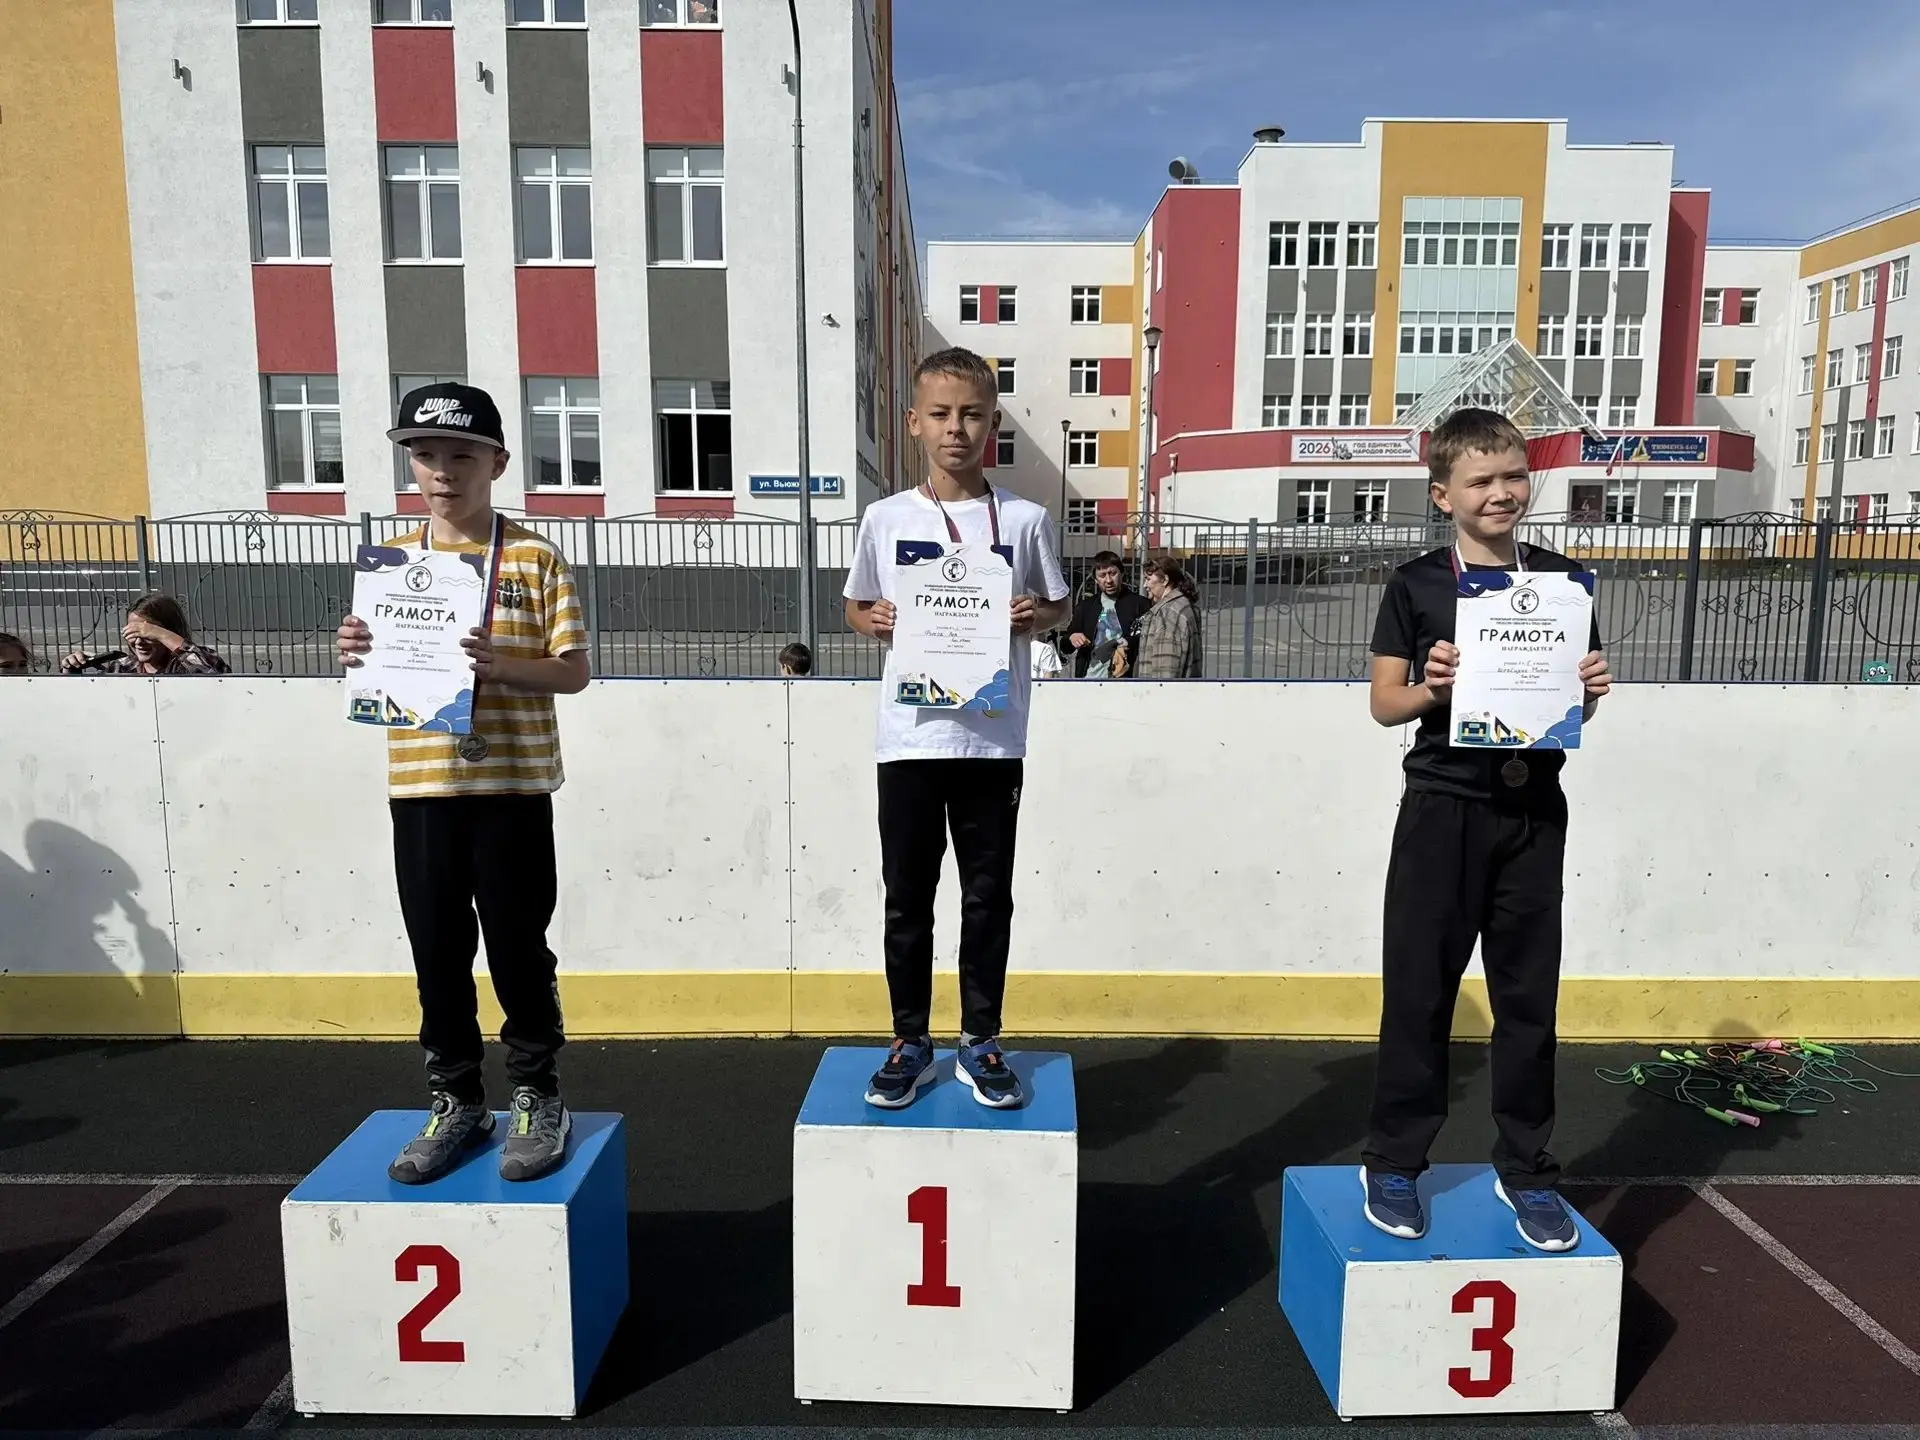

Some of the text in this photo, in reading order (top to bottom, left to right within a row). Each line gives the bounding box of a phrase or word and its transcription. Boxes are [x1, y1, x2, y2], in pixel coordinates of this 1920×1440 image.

[419, 398, 461, 412] JUMP
[436, 411, 473, 428] MAN
[1299, 442, 1331, 454] 2026
[759, 479, 811, 489] ул. Вьюж
[824, 480, 838, 490] д.4
[916, 594, 990, 610] ГРАМОТА
[375, 603, 457, 623] ГРАМОТА
[395, 622, 444, 631] НАГРАЖДАЕТСЯ
[1479, 628, 1566, 642] ГРАМОТА
[907, 1186, 961, 1308] 1
[394, 1244, 465, 1363] 2
[1448, 1280, 1517, 1399] 3
